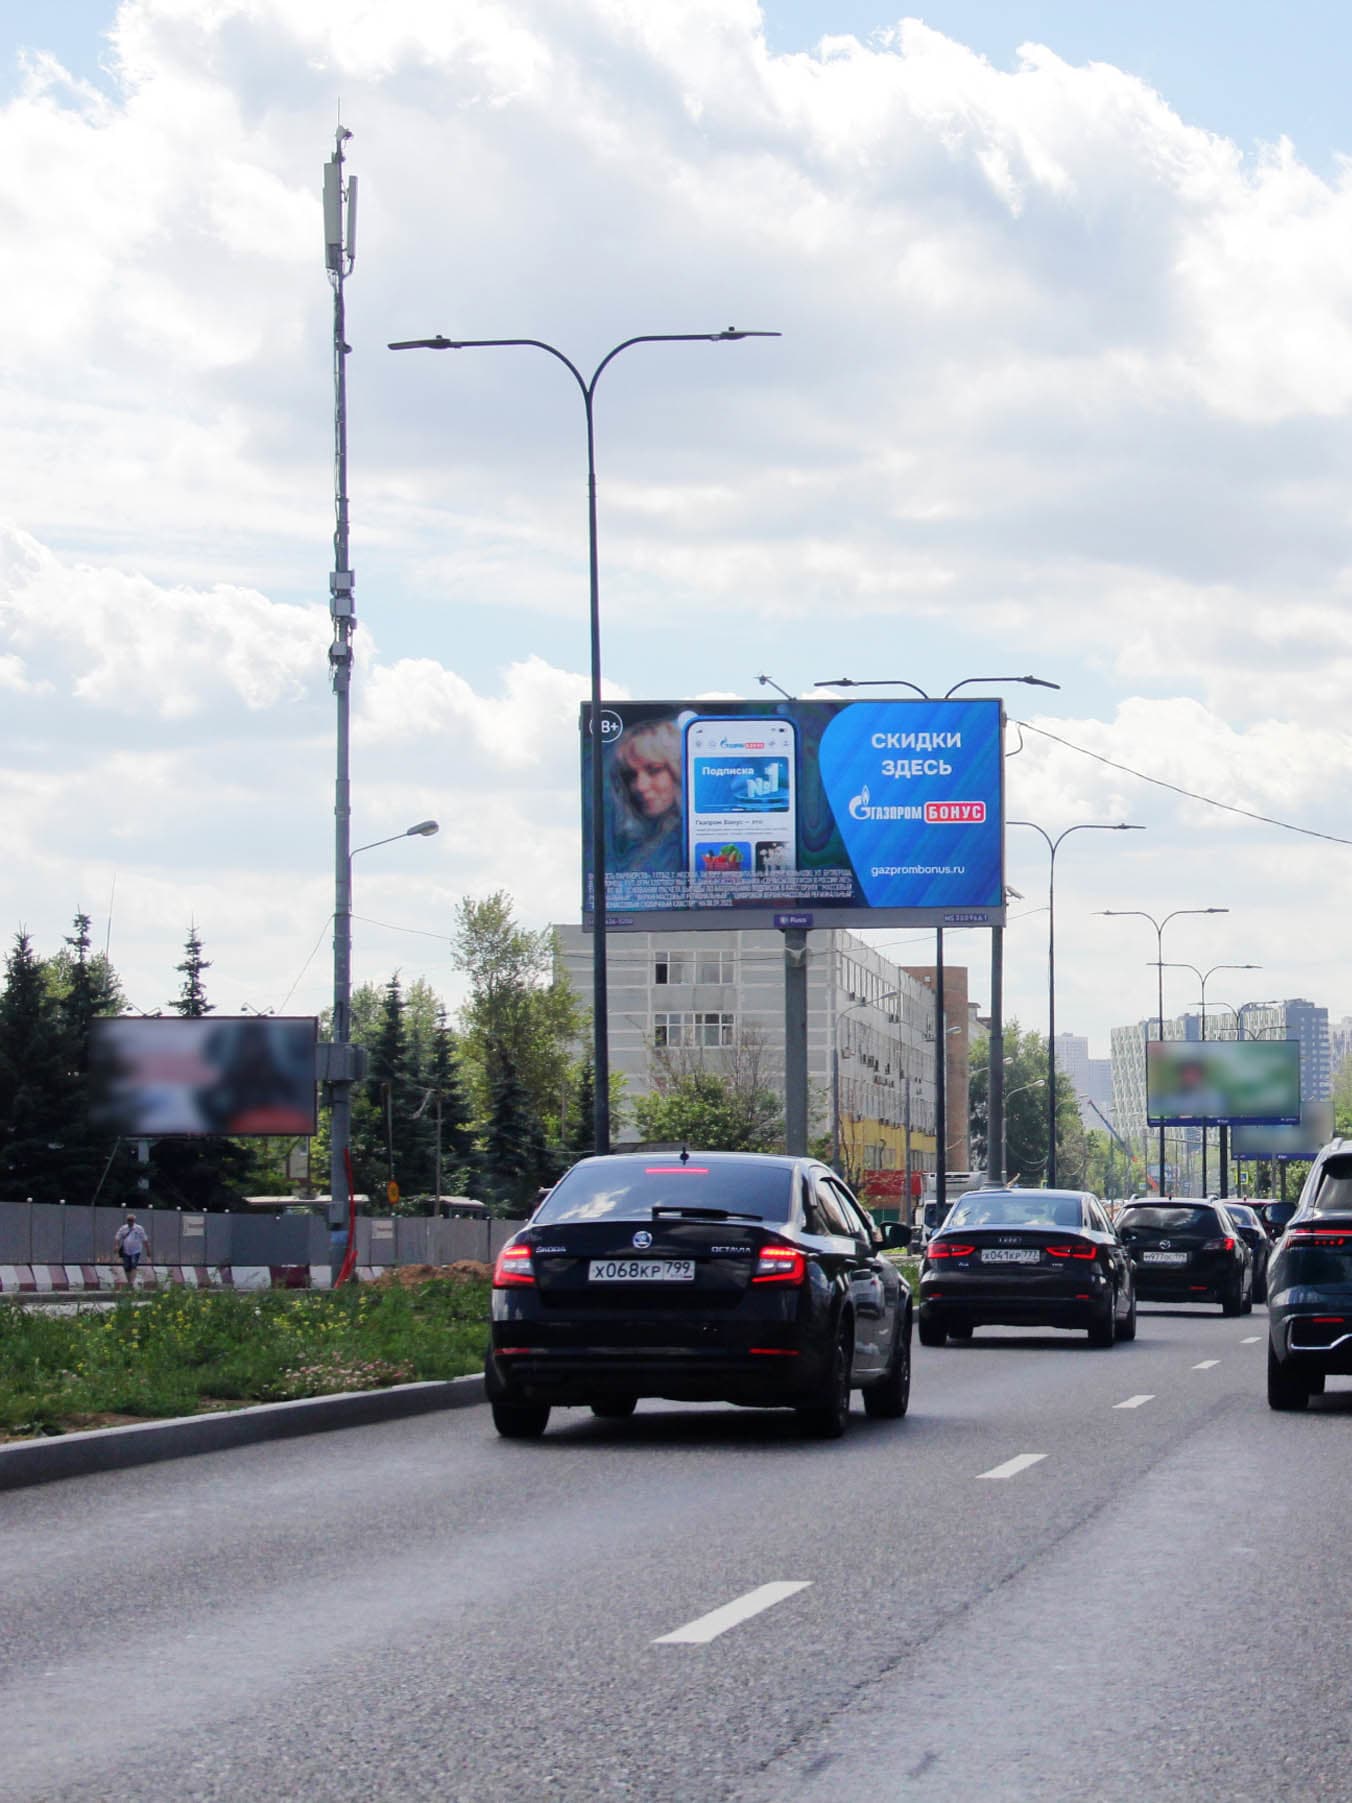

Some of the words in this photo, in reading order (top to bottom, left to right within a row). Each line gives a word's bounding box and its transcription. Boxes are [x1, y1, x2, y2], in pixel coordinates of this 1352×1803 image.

[871, 732, 962, 752] СКИДКИ
[702, 766, 754, 776] Подписка
[881, 759, 953, 779] ЗДЕСЬ
[871, 806, 922, 820] ГАЗПРОМ
[928, 805, 982, 820] БОНУС
[871, 865, 965, 877] gazprombonus.ru
